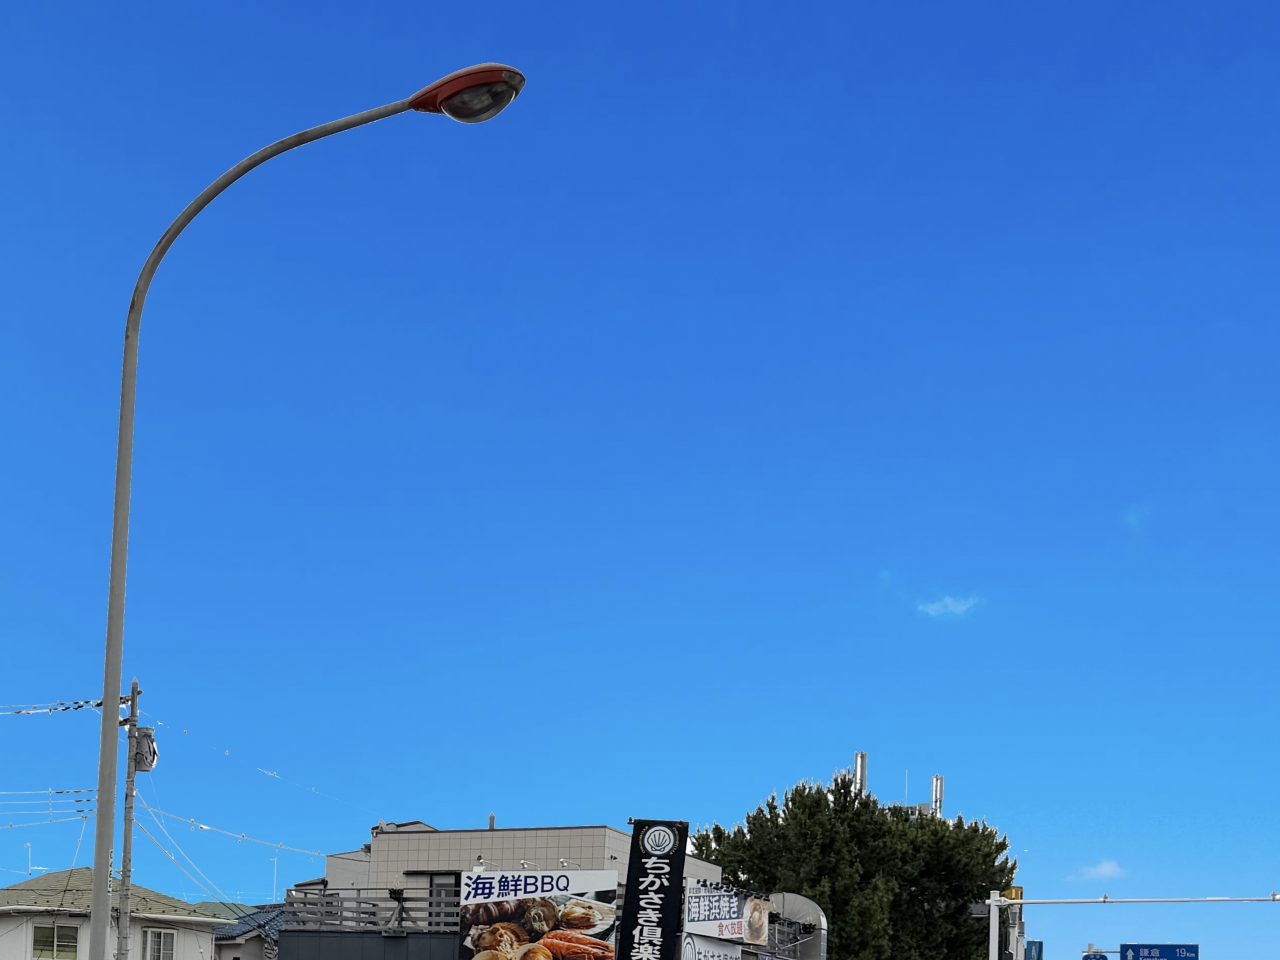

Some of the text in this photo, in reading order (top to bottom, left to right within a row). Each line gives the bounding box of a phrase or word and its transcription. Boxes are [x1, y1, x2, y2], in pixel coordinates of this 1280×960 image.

[464, 874, 570, 901] 海鮮BBQ
[688, 895, 739, 921] 海鮮浜焼き
[1176, 948, 1186, 957] 19
